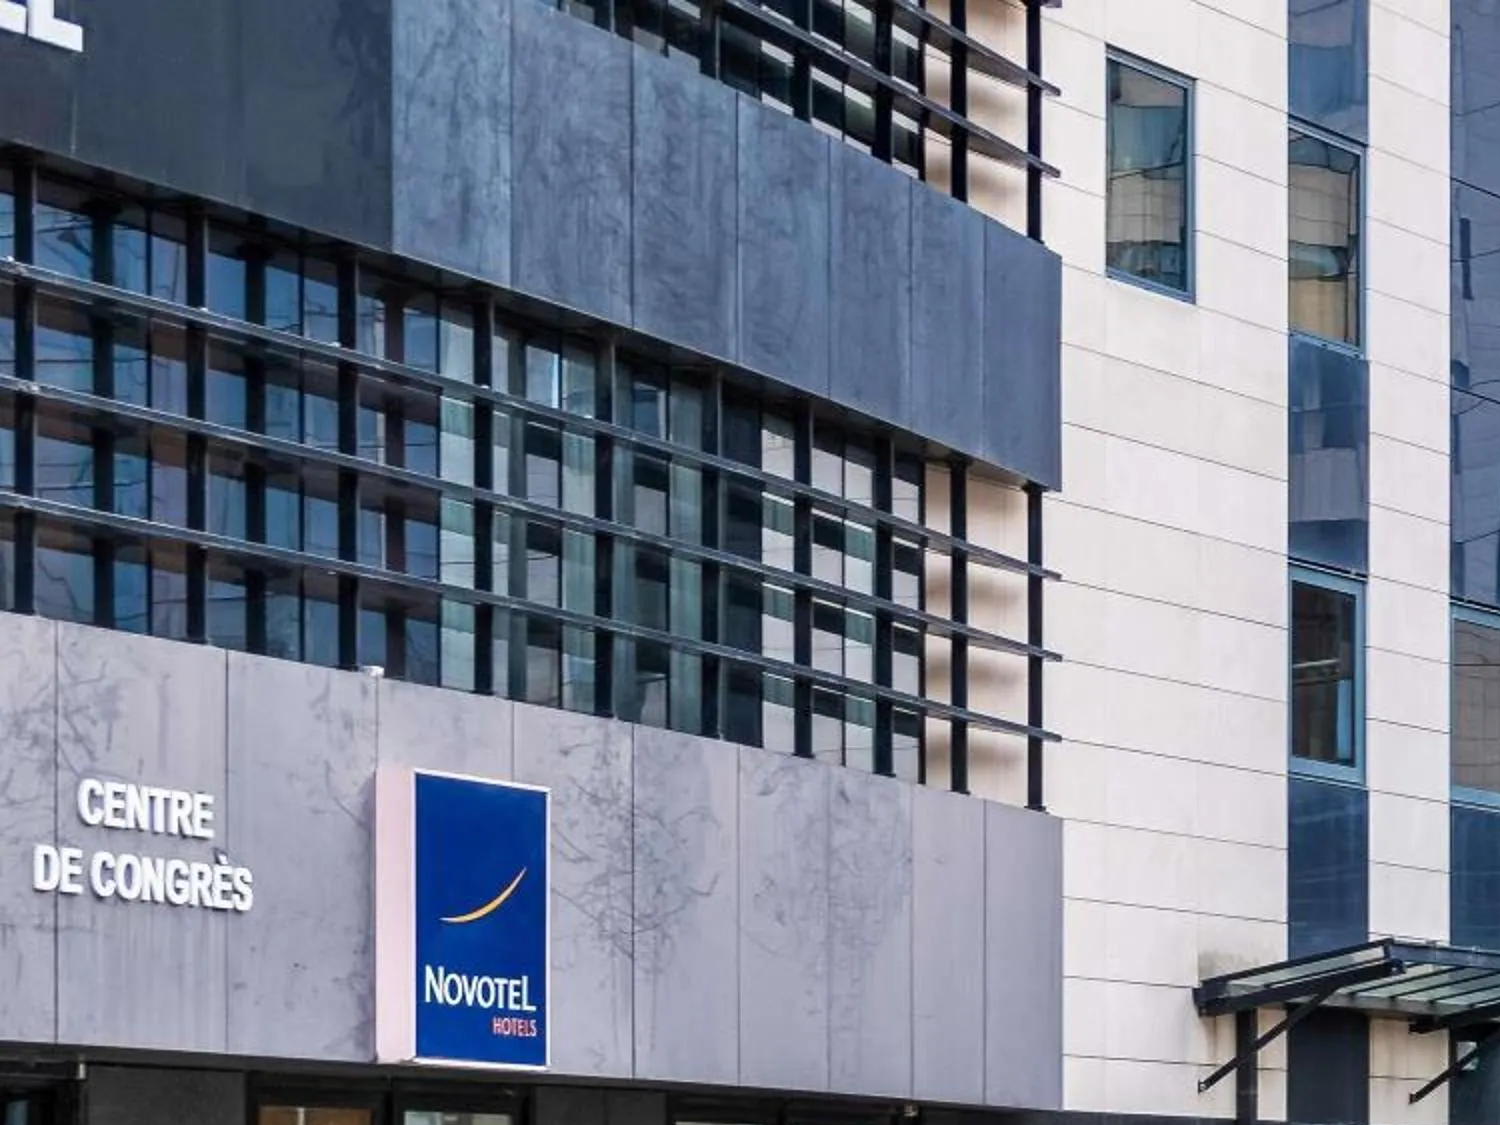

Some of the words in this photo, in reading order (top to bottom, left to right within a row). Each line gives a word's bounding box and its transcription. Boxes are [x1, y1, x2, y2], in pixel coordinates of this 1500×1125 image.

[78, 777, 215, 839] CENTRE
[33, 844, 83, 895] DE
[90, 851, 254, 913] CONGRÈS
[424, 965, 537, 1013] NOVOTEL
[492, 1017, 538, 1037] HOTELS
